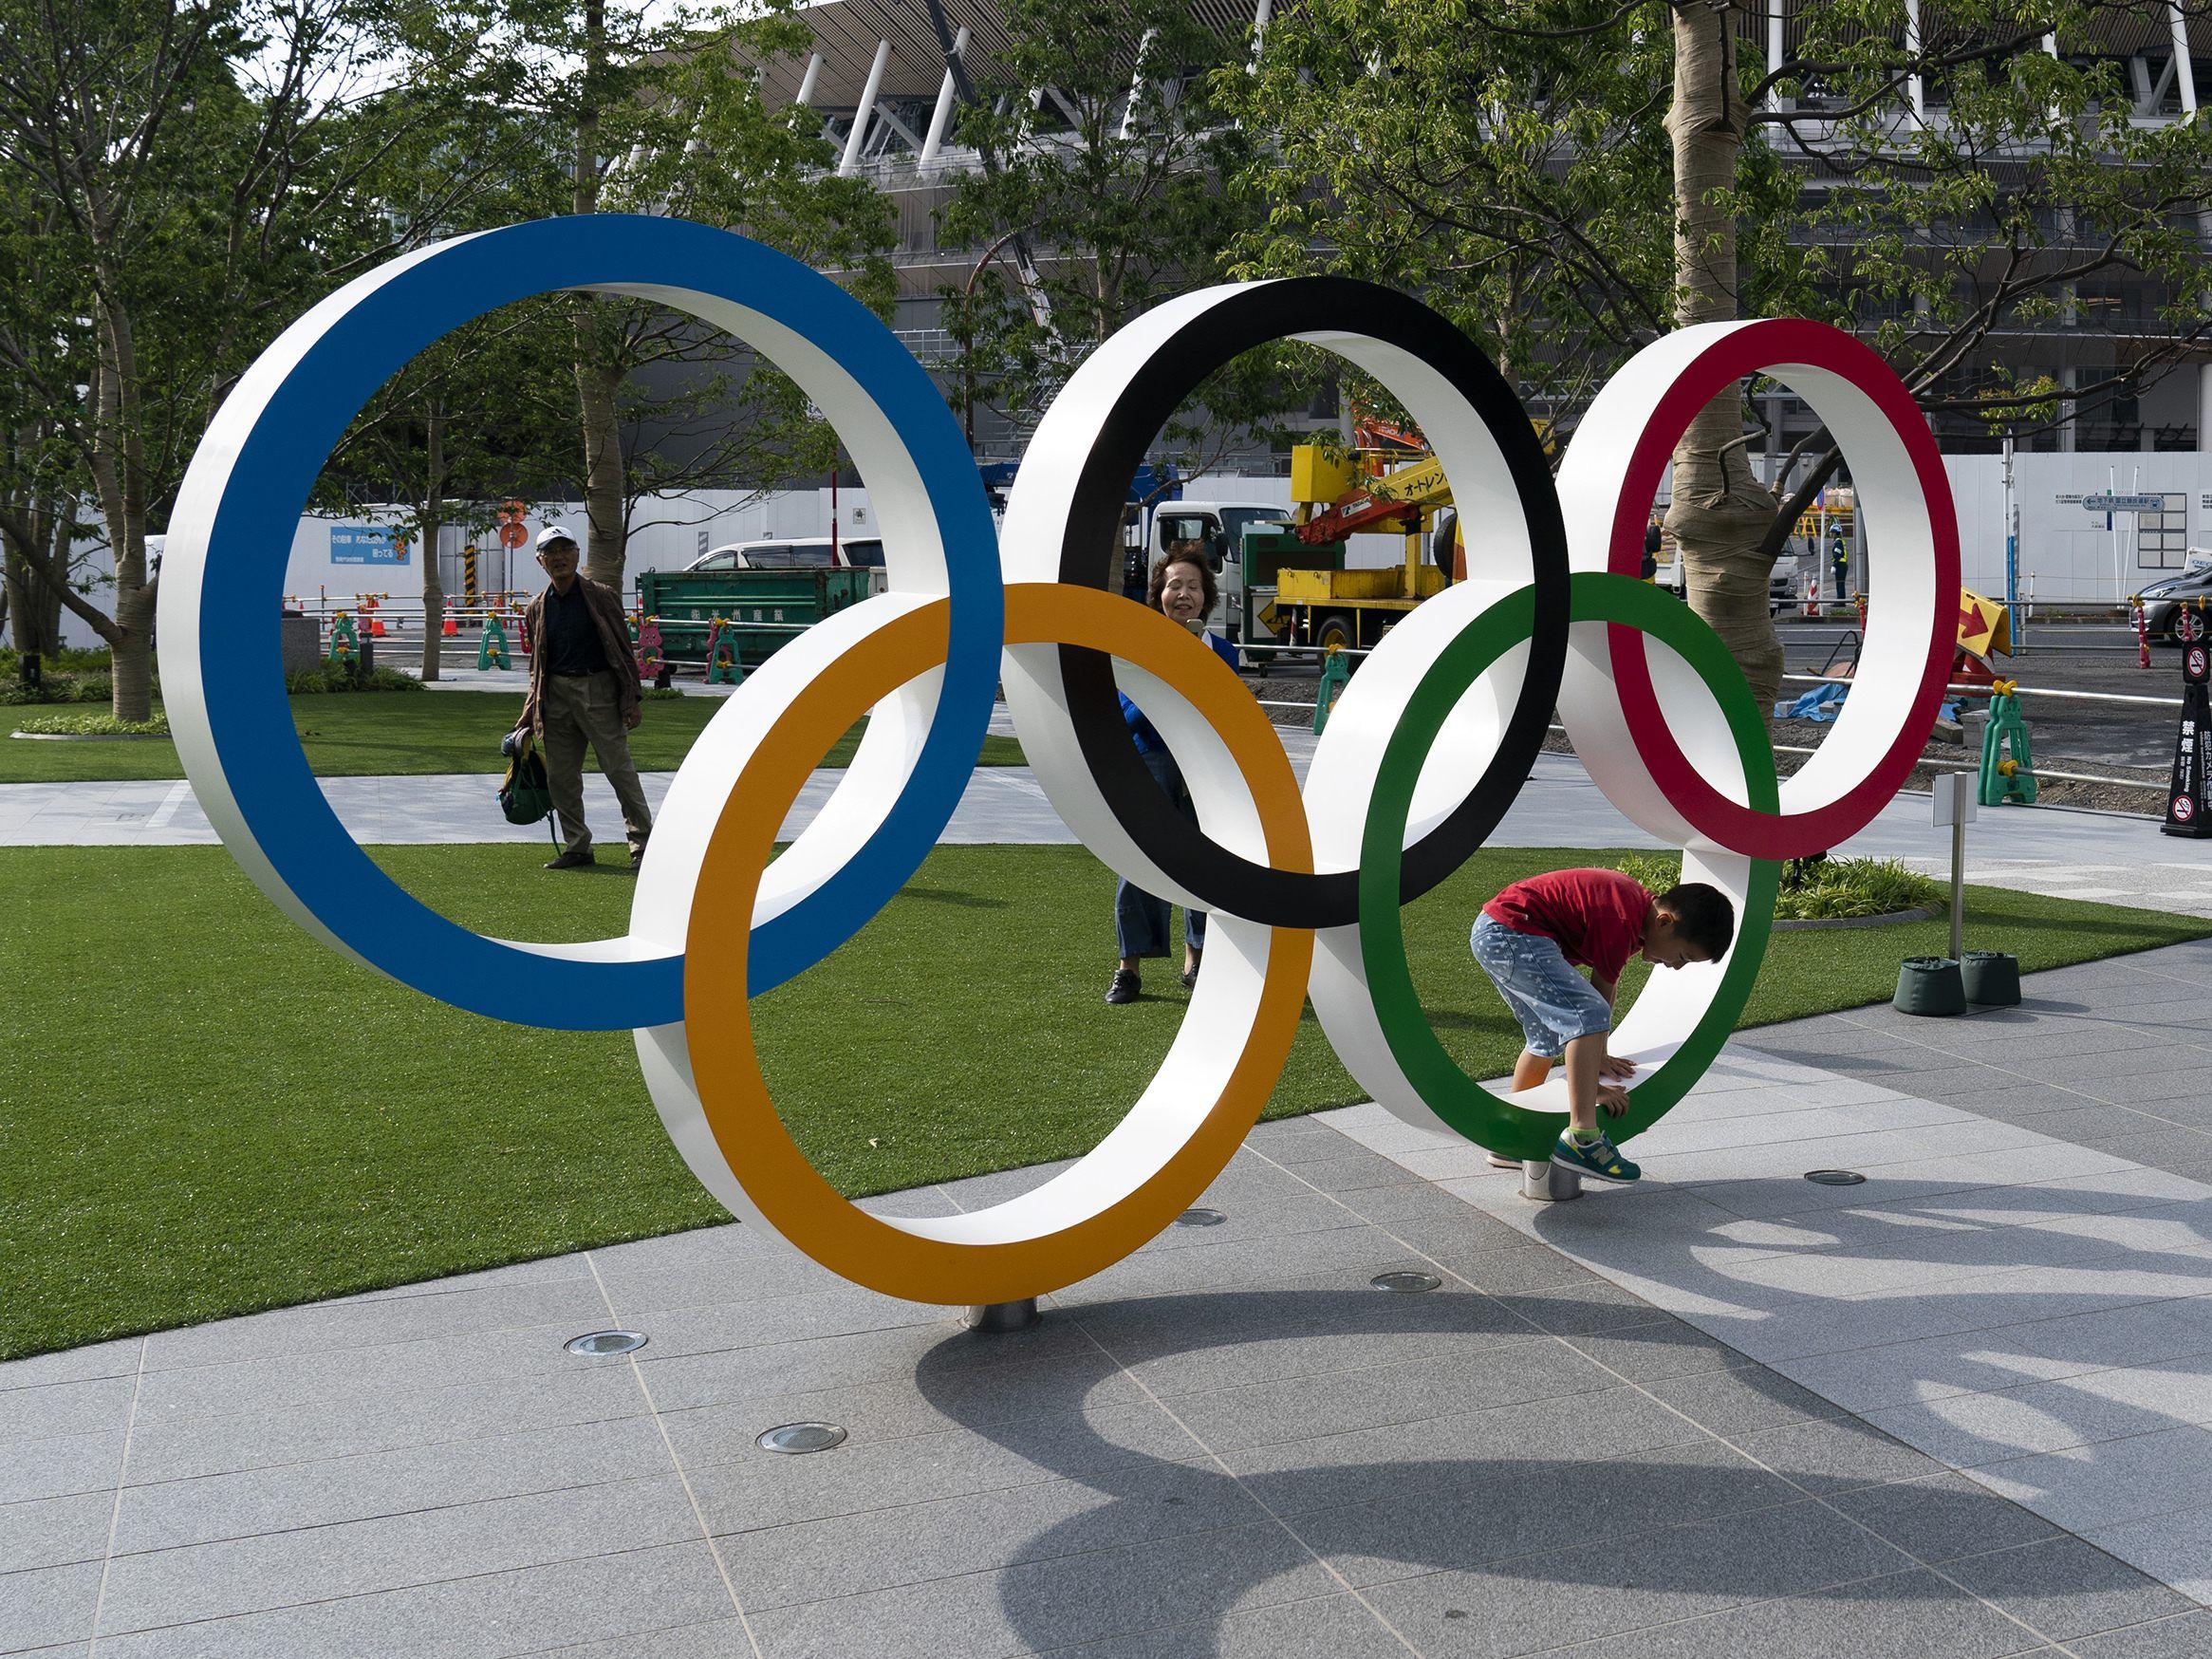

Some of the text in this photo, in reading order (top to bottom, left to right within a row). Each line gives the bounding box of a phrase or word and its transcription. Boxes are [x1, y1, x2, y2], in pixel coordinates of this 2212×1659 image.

[2181, 720, 2195, 754] 禁煙
[2184, 755, 2193, 792] No Smoking
[1590, 1146, 1615, 1165] N
